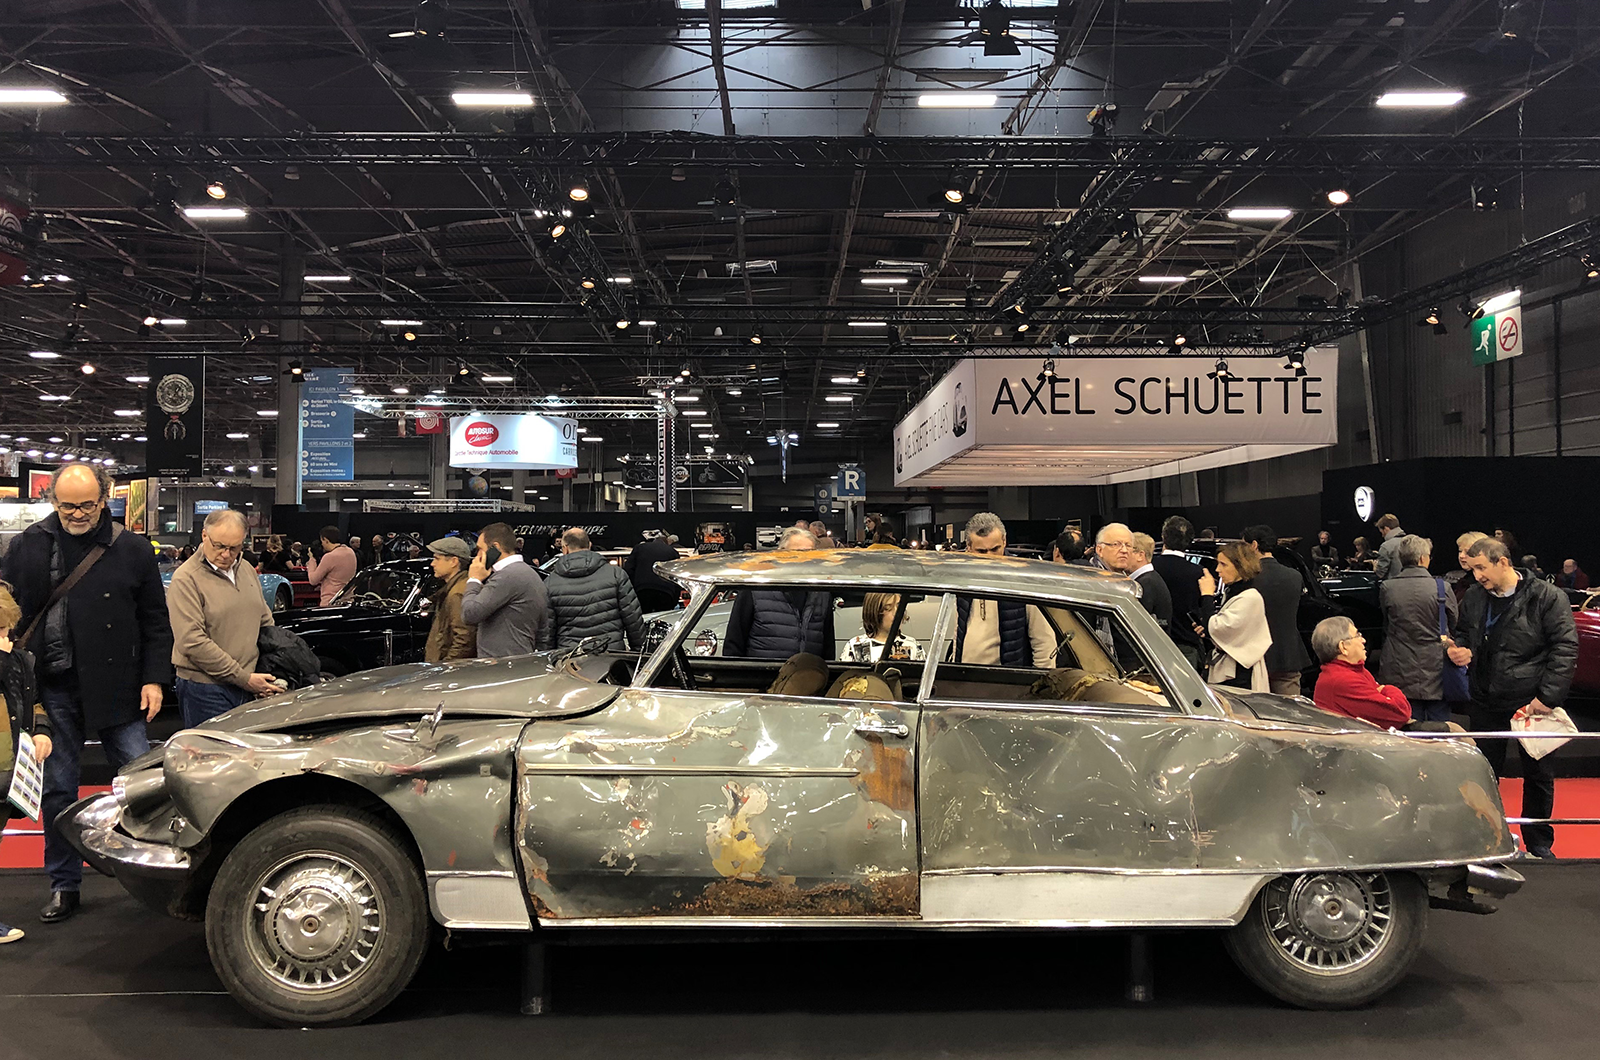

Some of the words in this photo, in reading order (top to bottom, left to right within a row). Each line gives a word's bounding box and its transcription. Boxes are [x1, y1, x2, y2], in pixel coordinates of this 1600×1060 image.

[991, 377, 1096, 415] AXEL
[1113, 377, 1323, 415] SCHUETTE
[468, 427, 494, 436] AUTOSUR
[845, 470, 860, 490] R
